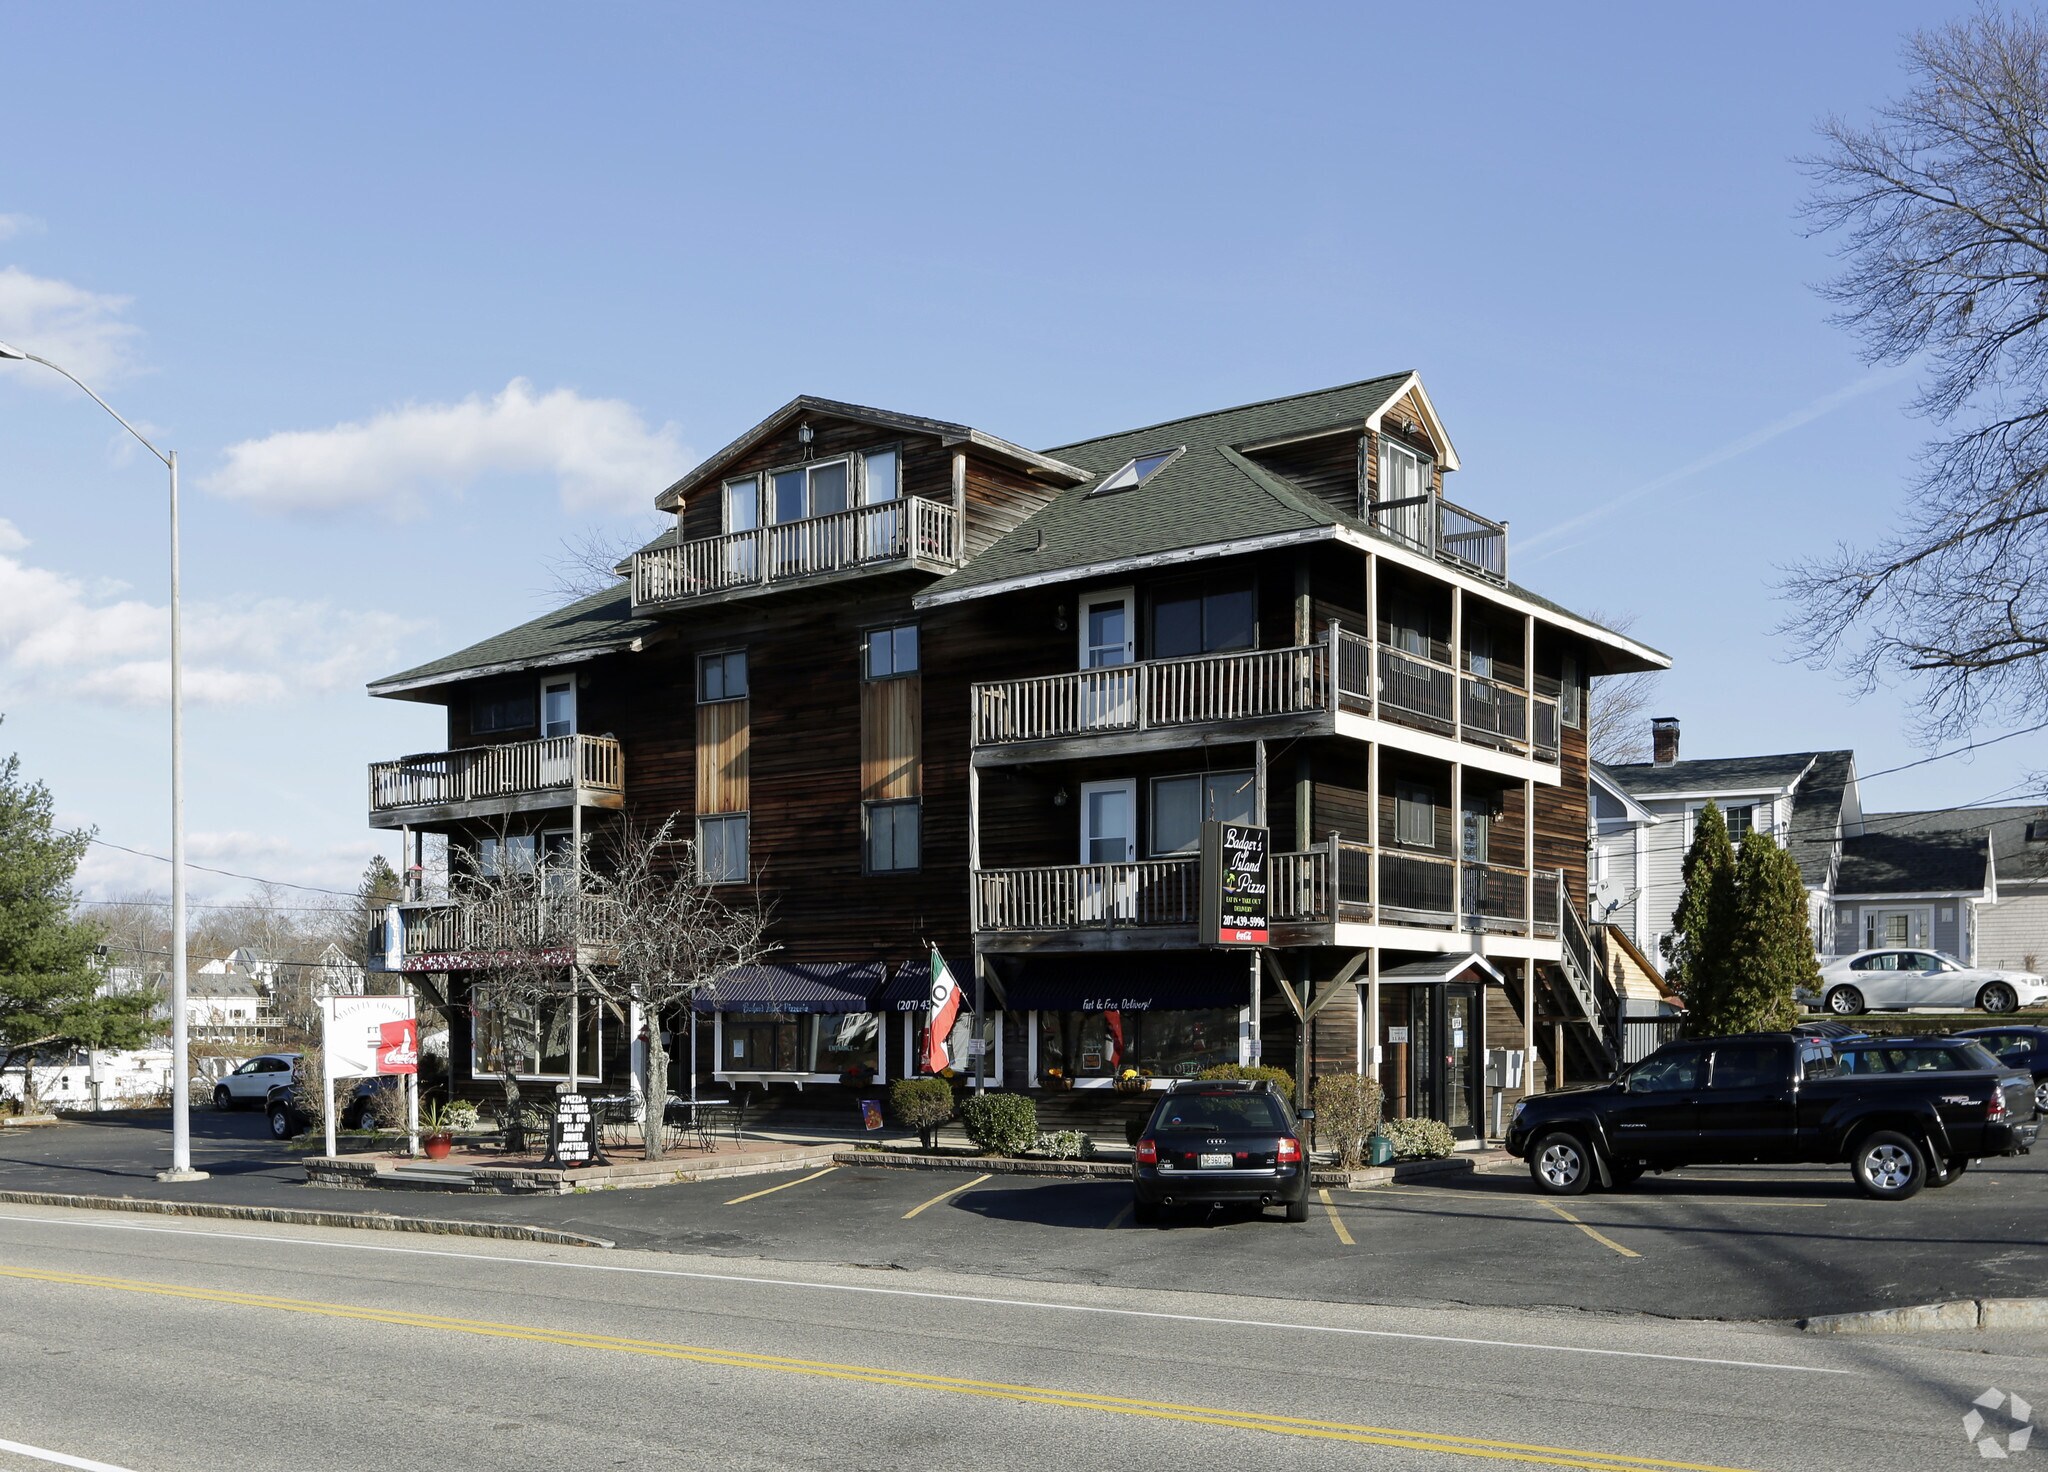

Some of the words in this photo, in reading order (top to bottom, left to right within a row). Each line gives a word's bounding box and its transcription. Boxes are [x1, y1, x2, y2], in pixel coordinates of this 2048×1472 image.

[1224, 828, 1262, 858] Badger's
[1230, 851, 1264, 872] Island
[1236, 873, 1266, 894] Pizza
[1233, 905, 1253, 913] DELIVERY
[1222, 915, 1266, 927] 207-439-5996
[897, 1000, 918, 1011] (207)
[1082, 999, 1095, 1010] Fast
[1096, 1000, 1103, 1010] &
[1103, 998, 1118, 1010] Free
[1121, 998, 1152, 1011] Delivery!
[565, 1095, 583, 1104] PIZZA
[560, 1104, 589, 1113] CALZONES
[557, 1113, 573, 1123] SUBS
[563, 1123, 585, 1132] SALADS
[557, 1141, 589, 1151] APPETIZER
